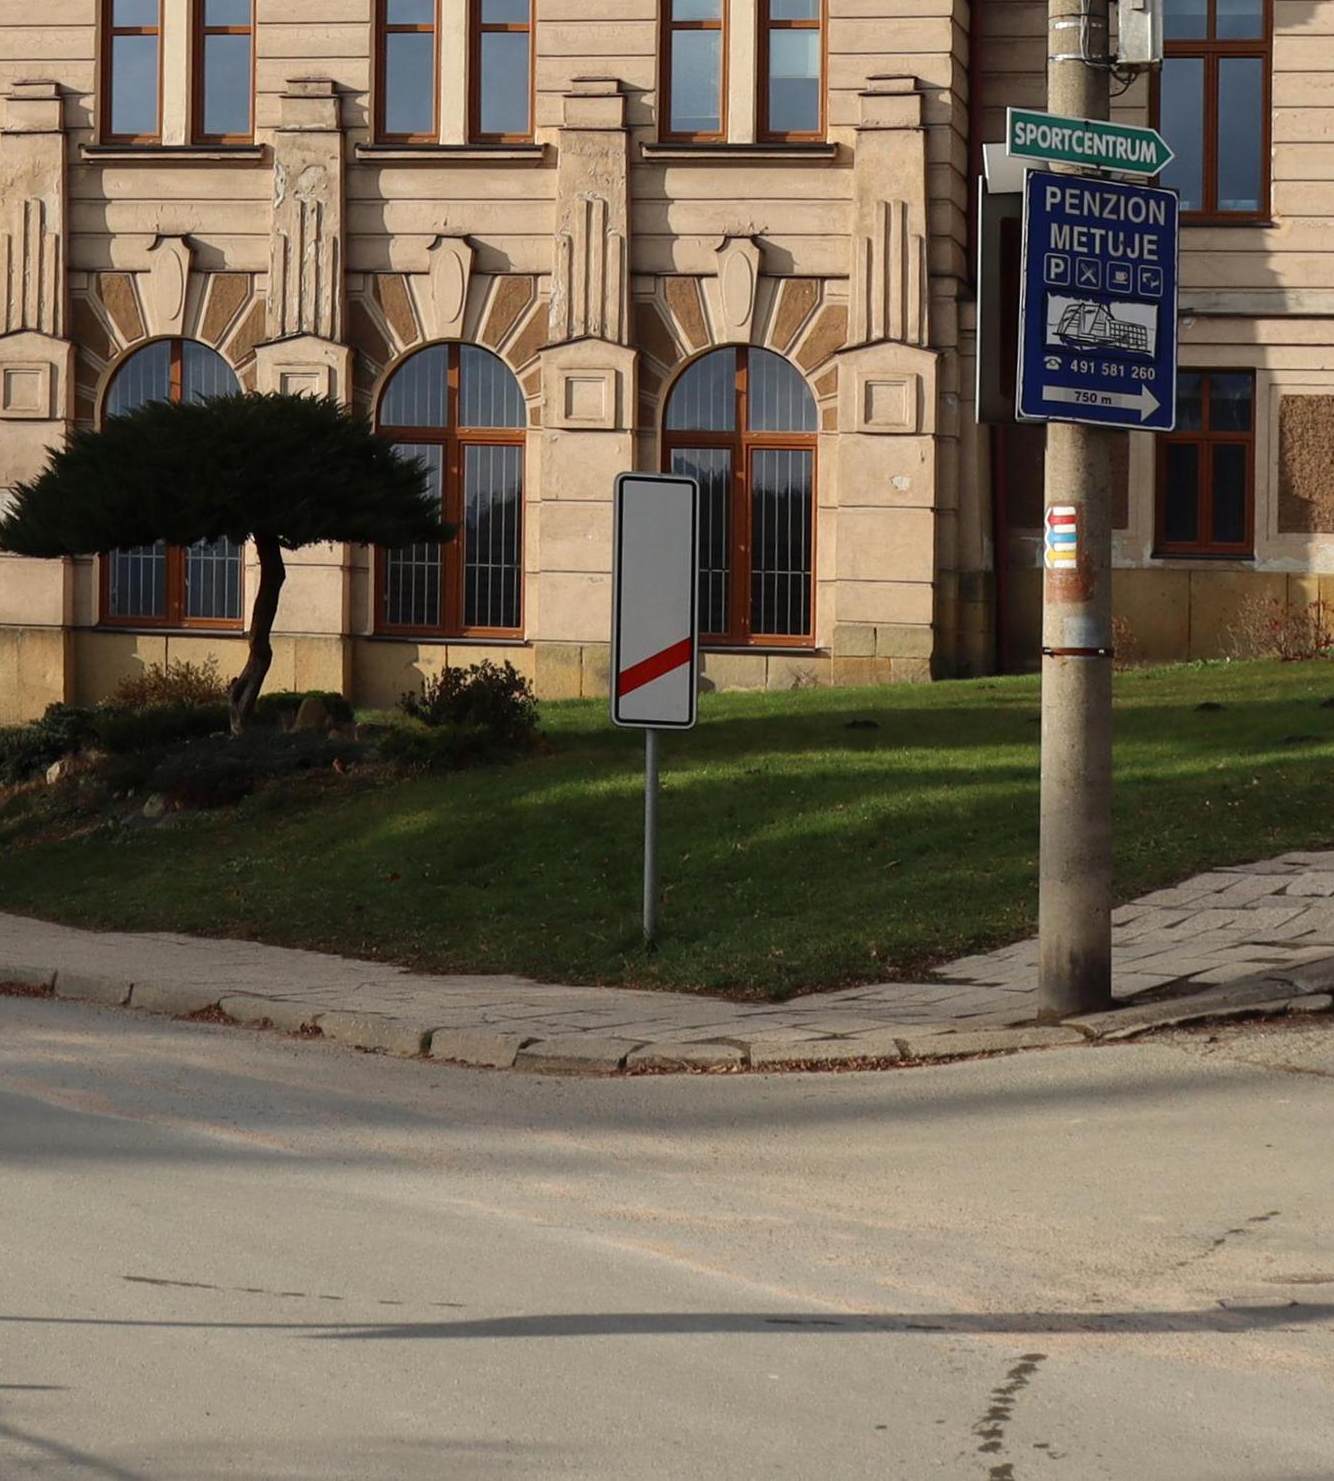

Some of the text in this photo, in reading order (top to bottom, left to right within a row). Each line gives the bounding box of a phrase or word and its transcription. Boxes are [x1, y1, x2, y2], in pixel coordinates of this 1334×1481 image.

[1014, 121, 1157, 165] SPORTCENTRUM
[1045, 186, 1166, 227] PENZION
[1050, 223, 1159, 261] METUJE
[1049, 259, 1065, 280] P
[1070, 359, 1156, 381] 491 581 260
[1074, 391, 1112, 405] 750 m
